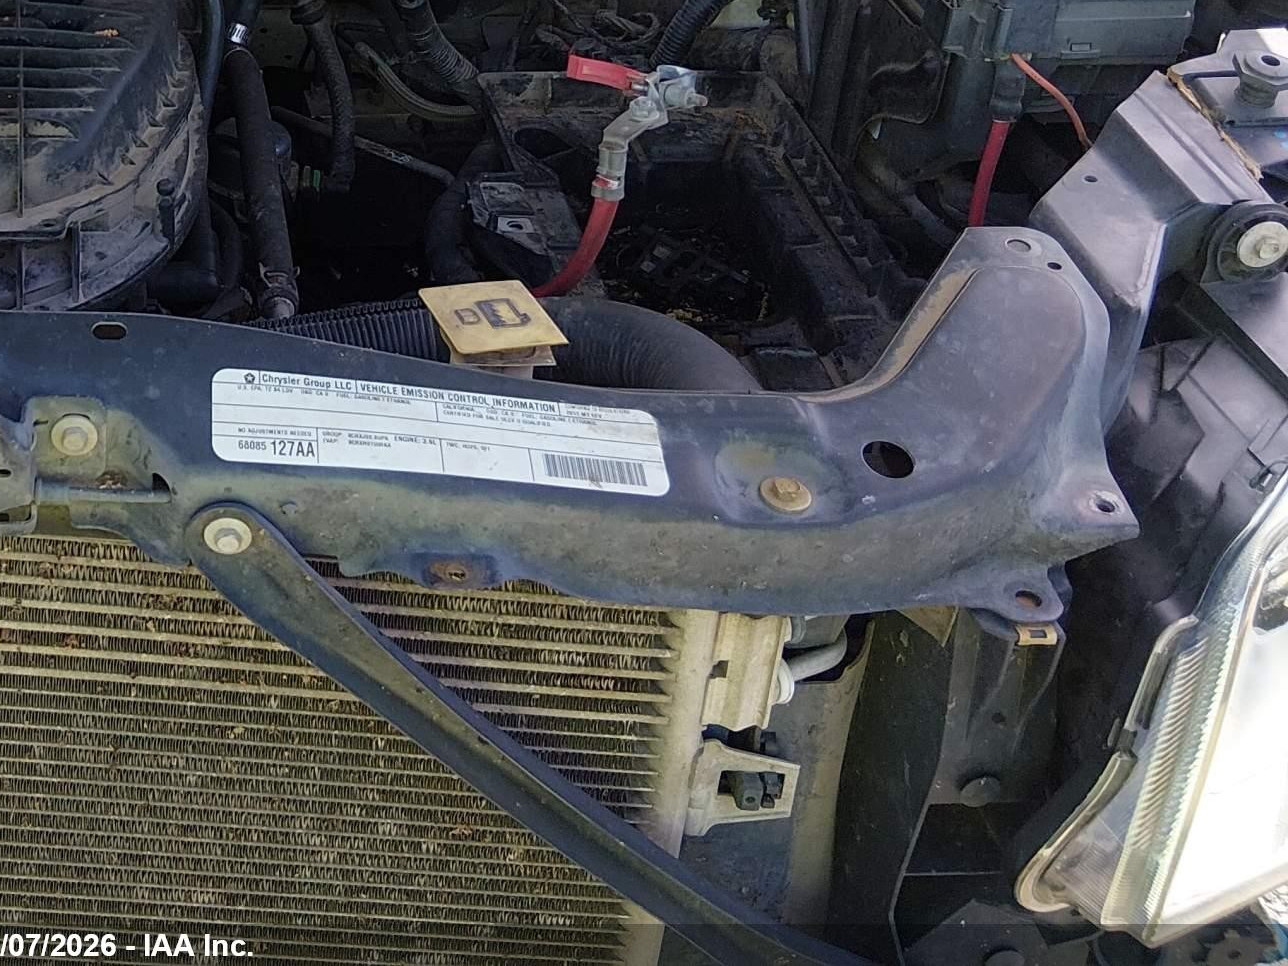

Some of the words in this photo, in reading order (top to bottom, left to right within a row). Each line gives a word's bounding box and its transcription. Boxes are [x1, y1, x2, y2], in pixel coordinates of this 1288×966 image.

[262, 373, 300, 386] Chrysler
[303, 377, 331, 389] Group
[334, 380, 352, 390] LLC
[360, 383, 399, 395] VEHICLE
[401, 387, 445, 400] EMISSION
[448, 393, 489, 406] CONTROL
[492, 397, 556, 413] INFORMATION
[238, 441, 267, 451] 68085
[270, 440, 316, 458] 127AA
